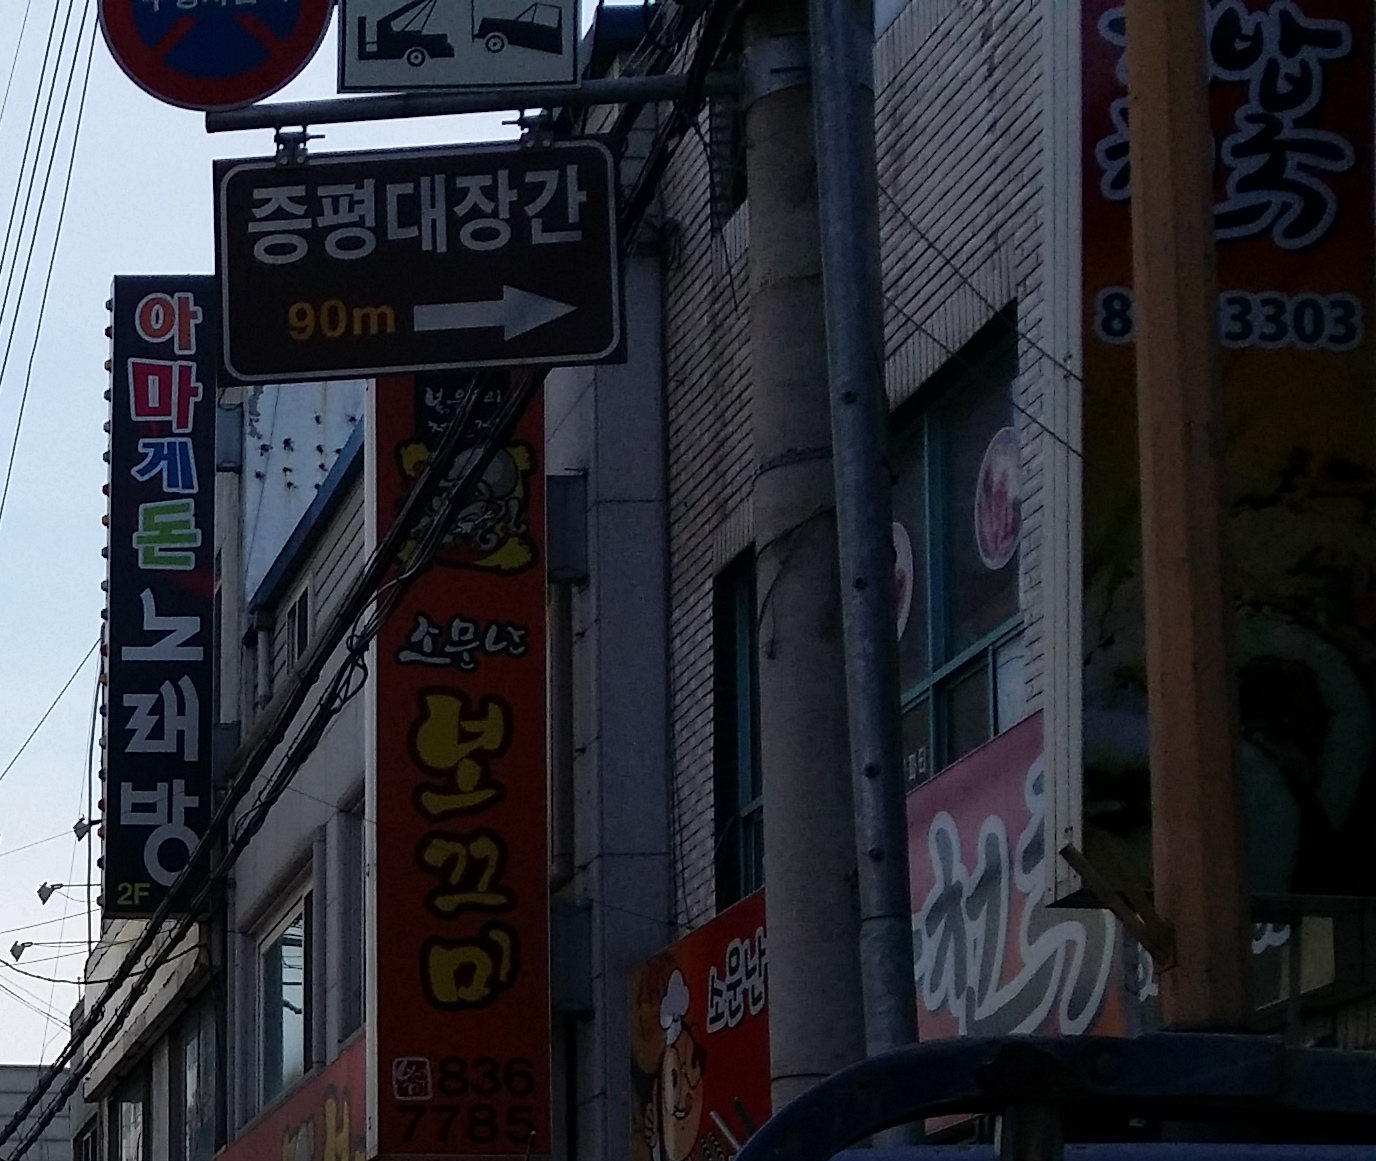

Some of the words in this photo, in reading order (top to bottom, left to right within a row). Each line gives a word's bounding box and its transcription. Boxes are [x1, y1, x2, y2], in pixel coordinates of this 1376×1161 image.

[248, 165, 588, 265] 증평대장간
[287, 298, 396, 340] 90m
[129, 291, 203, 571] 아마게돈
[120, 589, 205, 888] 노래방
[117, 883, 151, 906] 2F
[437, 1056, 535, 1097] 836
[396, 1103, 537, 1143] 7785
